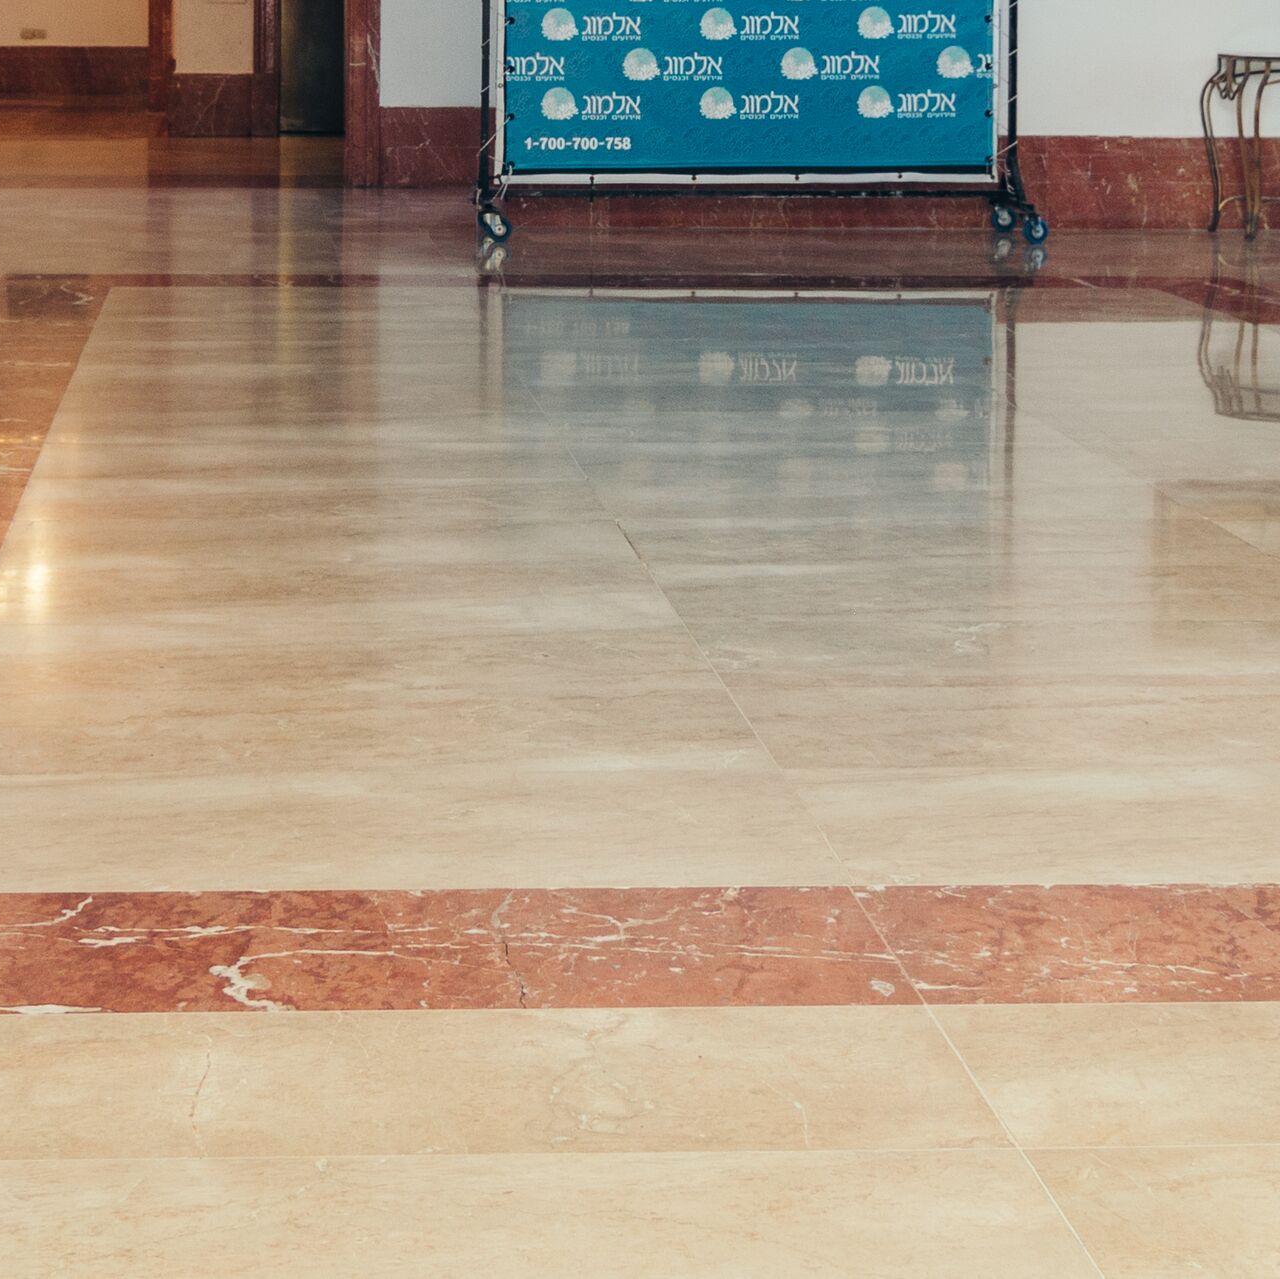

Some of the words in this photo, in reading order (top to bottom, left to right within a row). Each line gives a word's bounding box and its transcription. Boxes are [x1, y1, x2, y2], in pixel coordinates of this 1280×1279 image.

[582, 12, 641, 34] אלמוג
[740, 12, 799, 34] אלמוג
[897, 10, 956, 32] אלמוג
[663, 53, 722, 75] אלמוג
[821, 52, 880, 74] אלמוג
[582, 92, 641, 114] אלמוג
[740, 92, 799, 114] אלמוג
[897, 90, 956, 112] אלמוג
[524, 137, 632, 150] 1-700-700-758
